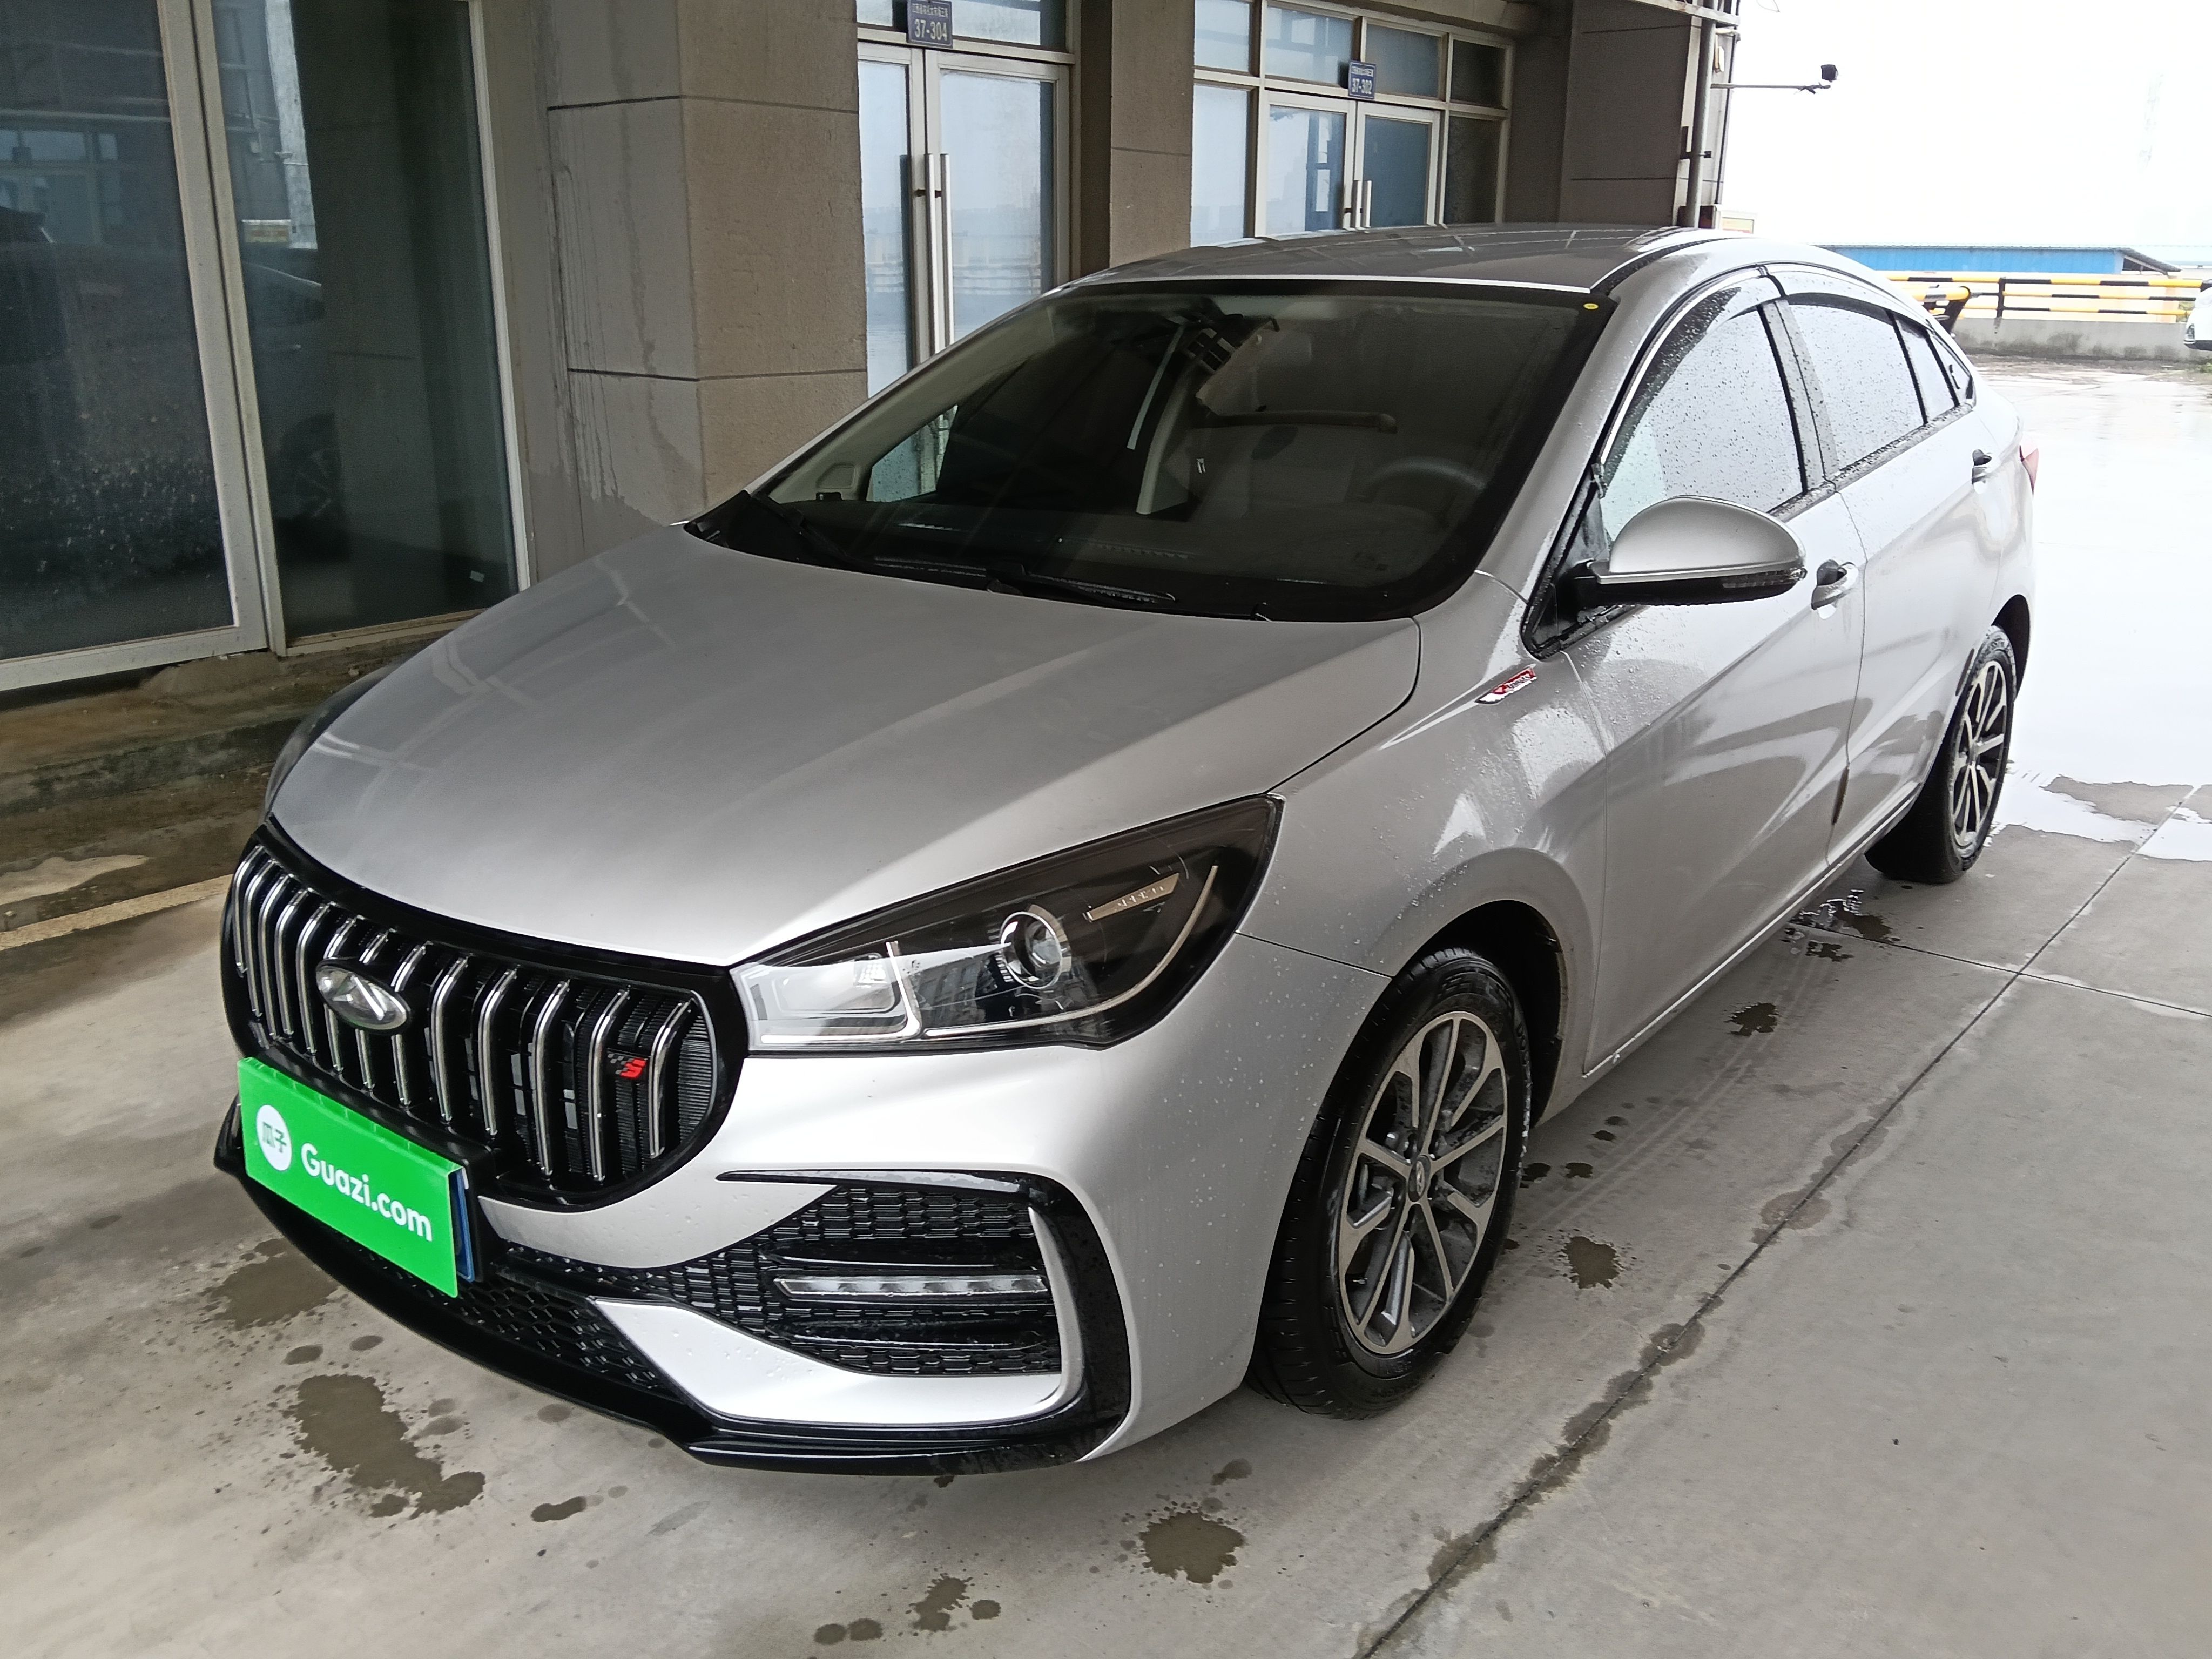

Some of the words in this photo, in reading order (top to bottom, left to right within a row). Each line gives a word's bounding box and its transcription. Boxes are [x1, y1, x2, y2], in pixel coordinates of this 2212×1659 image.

[914, 18, 947, 41] 37-304
[262, 1121, 287, 1154] 瓜子
[300, 1142, 433, 1242] Guazi.com
